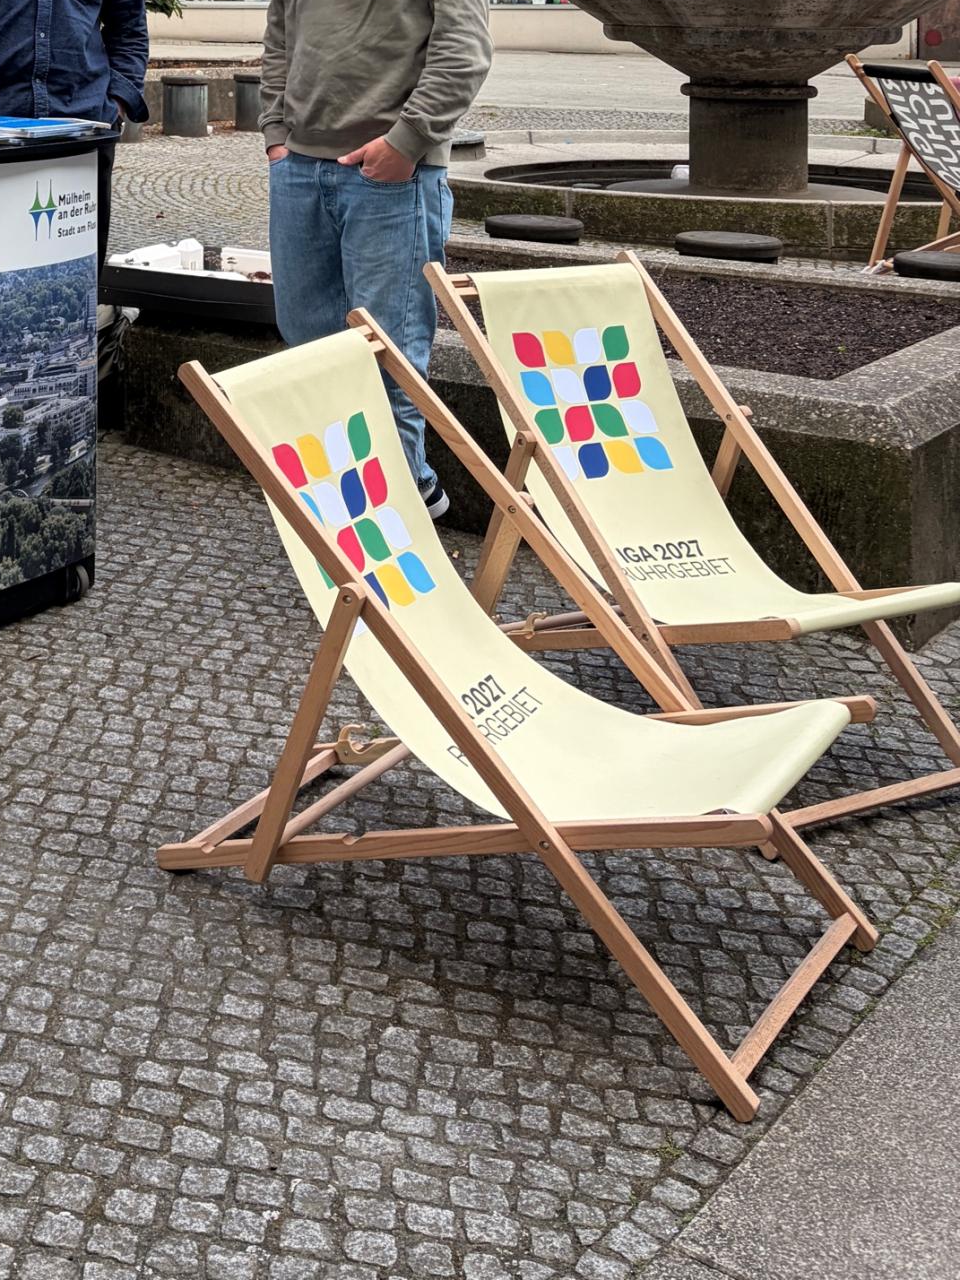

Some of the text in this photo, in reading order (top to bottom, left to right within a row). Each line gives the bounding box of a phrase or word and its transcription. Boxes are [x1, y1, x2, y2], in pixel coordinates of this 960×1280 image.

[58, 190, 91, 206] Mülheim
[57, 210, 68, 220] an
[70, 206, 83, 217] der
[57, 225, 75, 238] Stadt
[77, 225, 86, 233] am
[615, 539, 704, 563] IGA 2027
[461, 674, 506, 715] 2027
